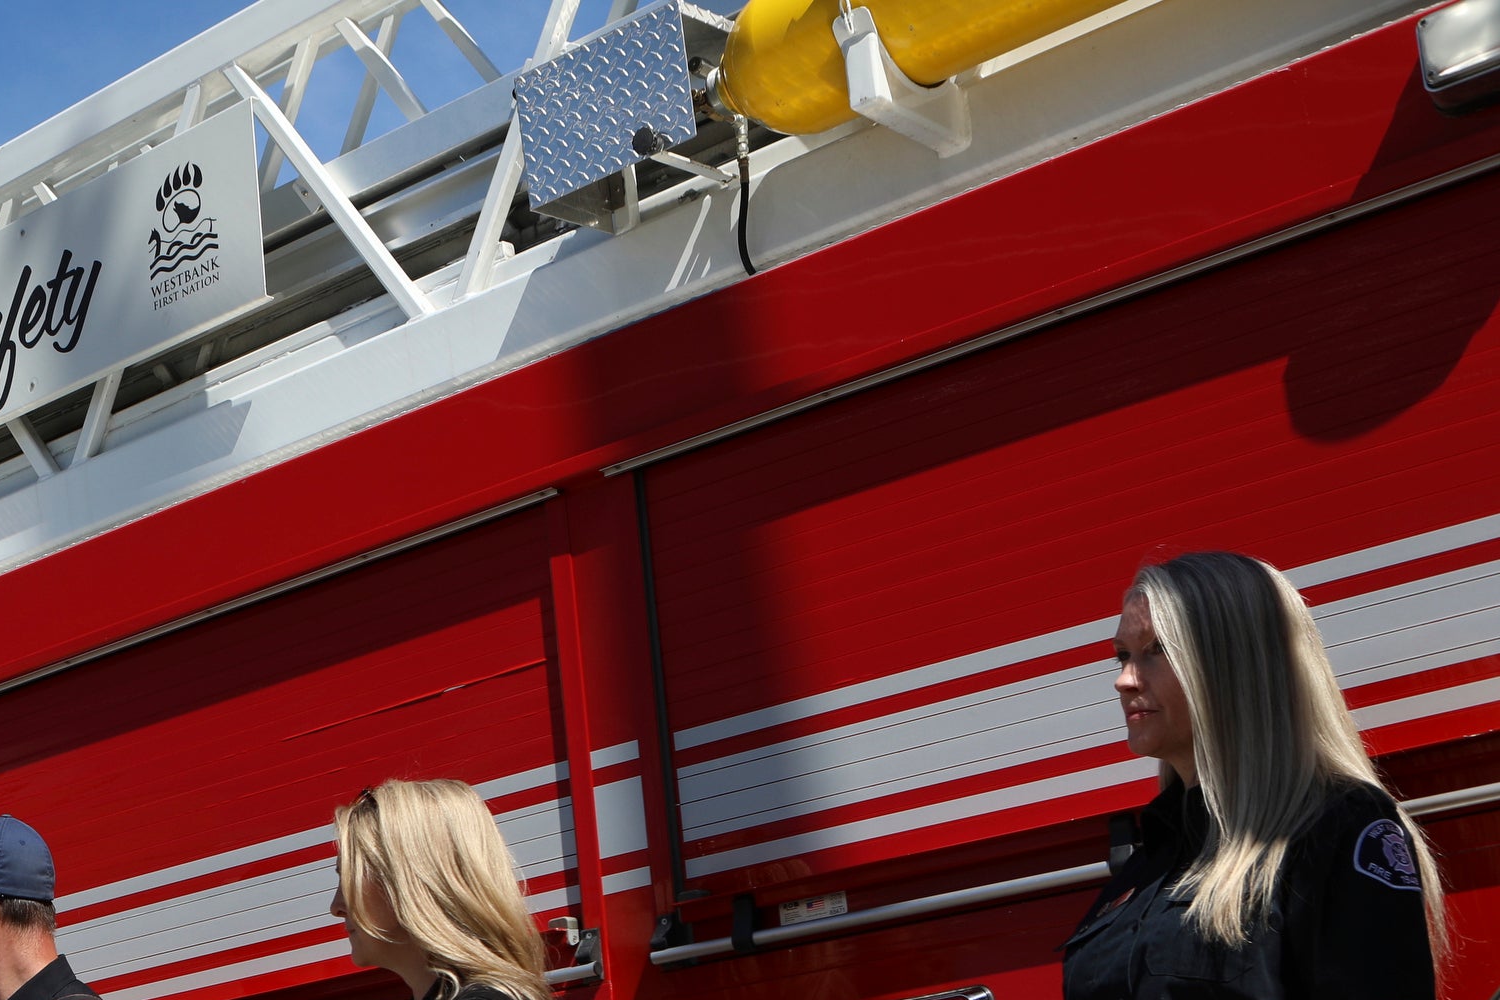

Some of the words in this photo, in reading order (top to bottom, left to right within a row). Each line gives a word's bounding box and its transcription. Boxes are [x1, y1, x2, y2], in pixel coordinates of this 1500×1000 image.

[151, 256, 220, 298] WESTBANK
[154, 291, 179, 310] FIRST
[182, 272, 219, 297] NATION
[1368, 862, 1392, 880] FIRE
